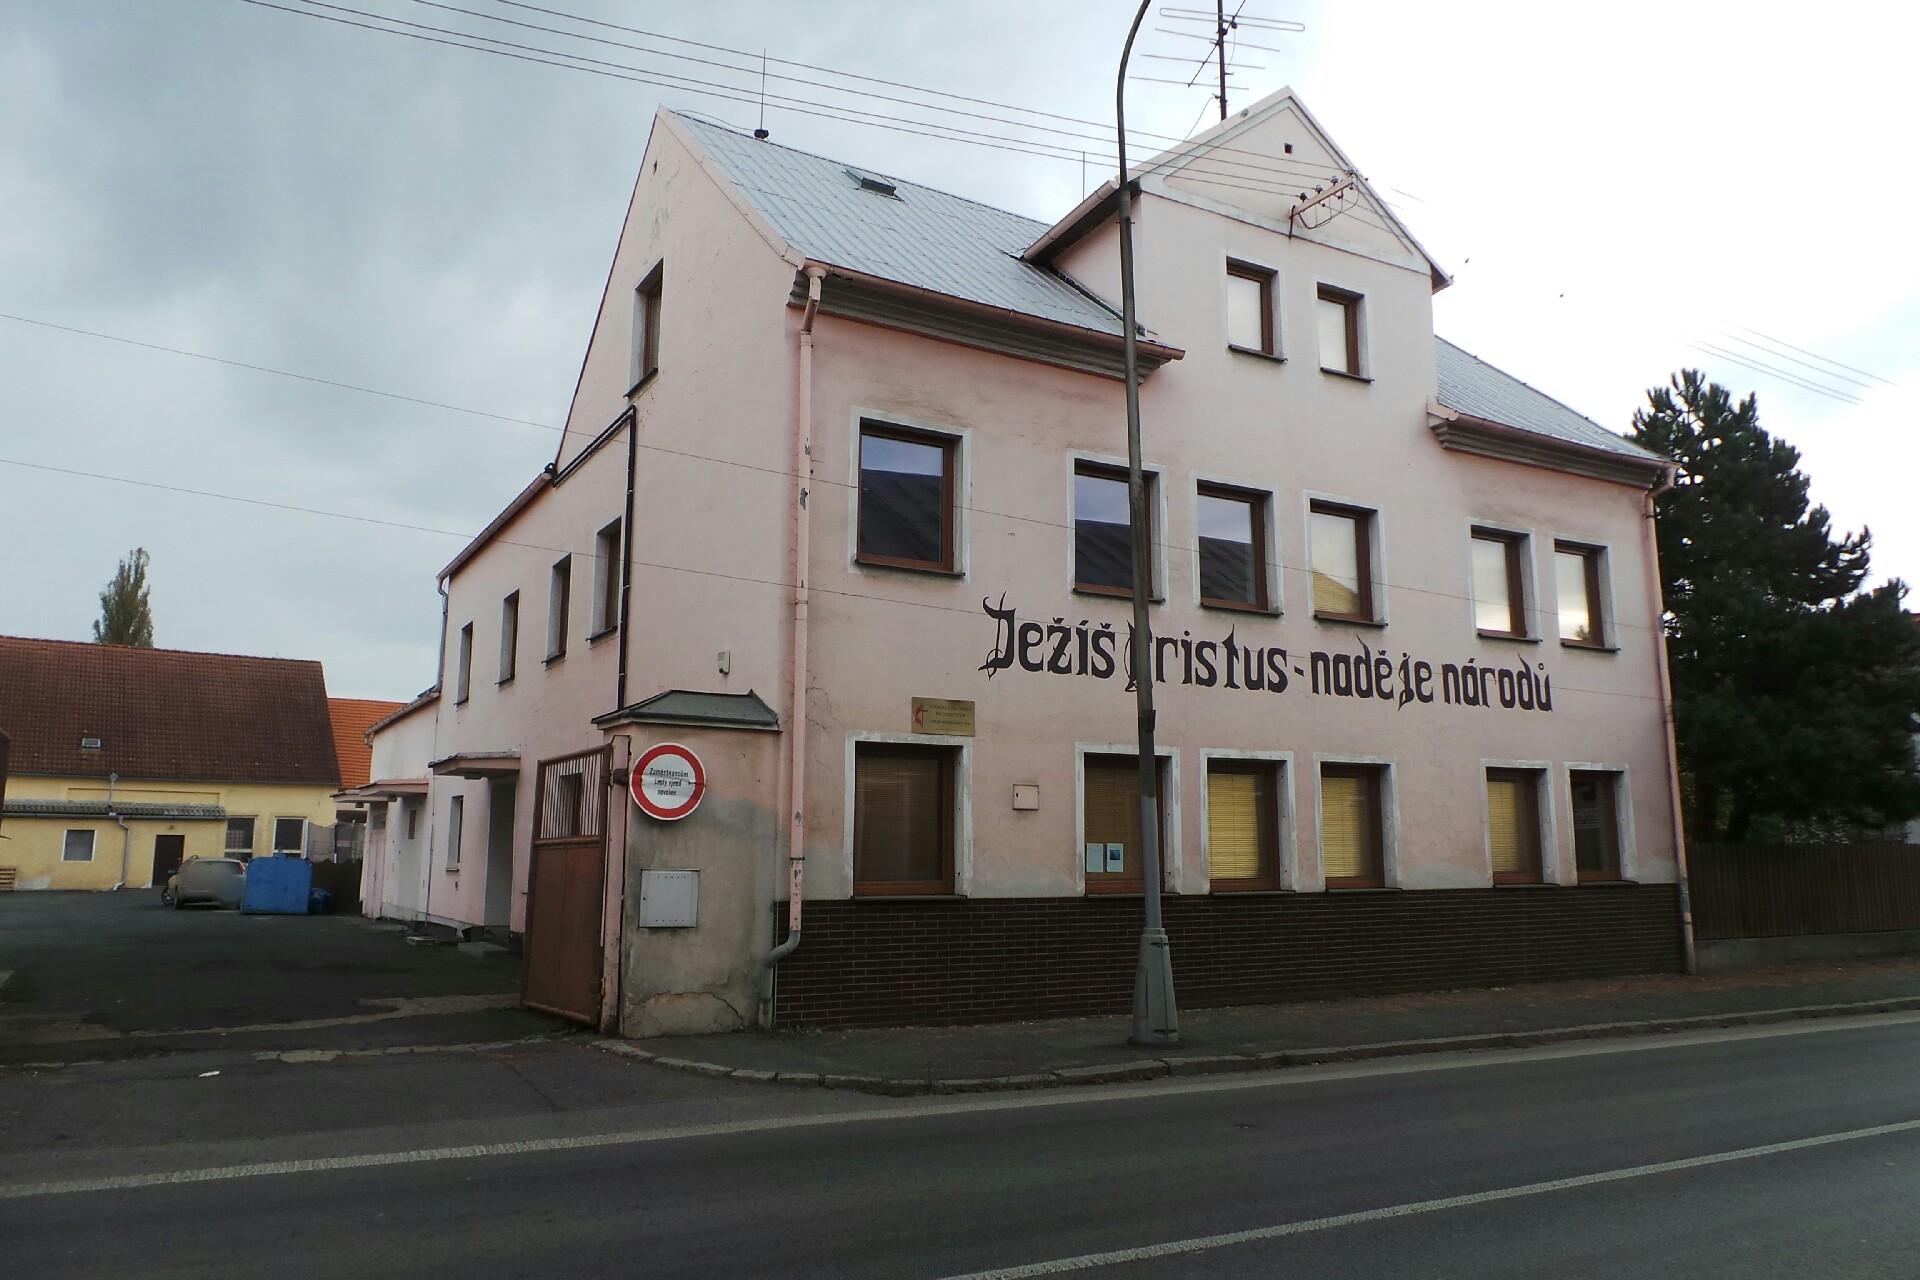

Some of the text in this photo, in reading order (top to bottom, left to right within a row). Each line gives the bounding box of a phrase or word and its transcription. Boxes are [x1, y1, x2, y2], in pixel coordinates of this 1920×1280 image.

[978, 590, 1116, 682] Ježíš
[1310, 634, 1434, 711] naděje
[1441, 652, 1553, 712] národů
